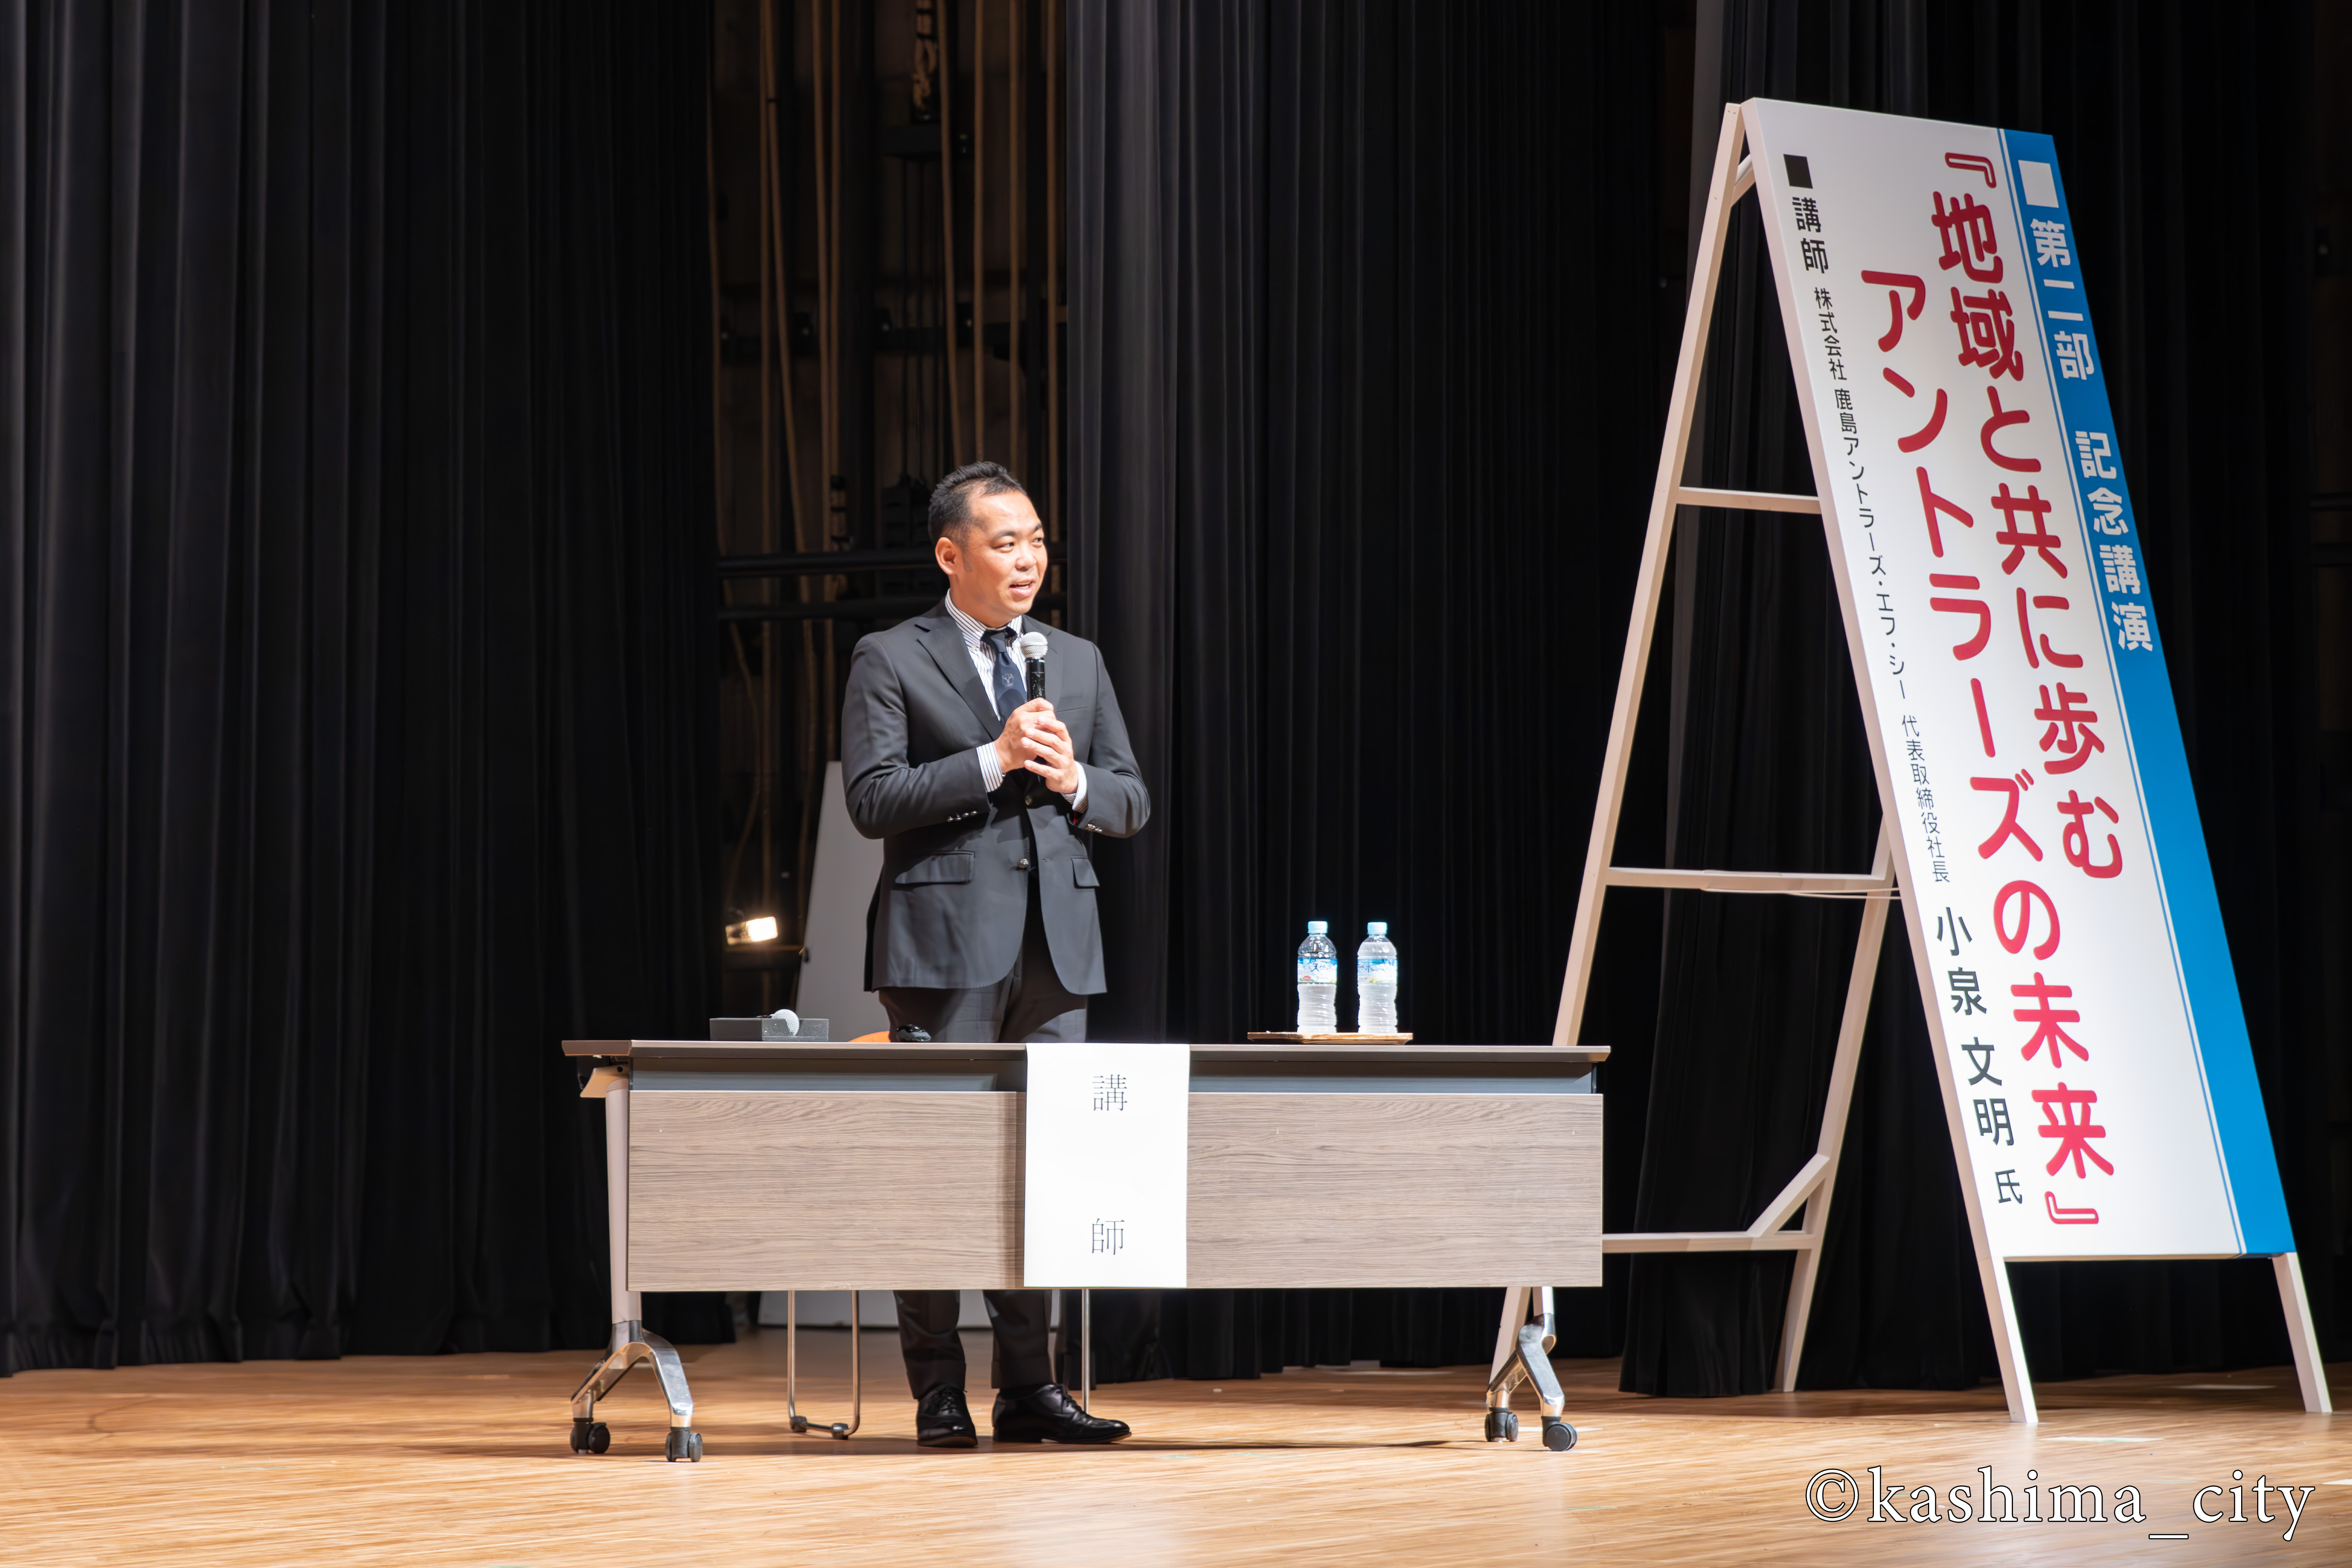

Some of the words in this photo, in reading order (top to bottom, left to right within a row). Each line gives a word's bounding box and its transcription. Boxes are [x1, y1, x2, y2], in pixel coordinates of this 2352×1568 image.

[1792, 196, 1829, 274] 講師
[1814, 286, 1847, 381] 株式会社
[2030, 219, 2094, 380] 第二部
[2075, 430, 2153, 652] 記念講演
[1834, 387, 1906, 699] 鹿島アントラーズ・エフ・シー
[1931, 152, 2123, 879] 『地域と共に歩む
[1861, 270, 2114, 1224] アントラーズの未来』
[1902, 715, 1950, 883] 代表取締役社長
[1311, 963, 1333, 973] 天然水
[1936, 906, 1987, 1015] 小泉
[1961, 1037, 2014, 1146] 文明
[1994, 1169, 2022, 1204] 氏
